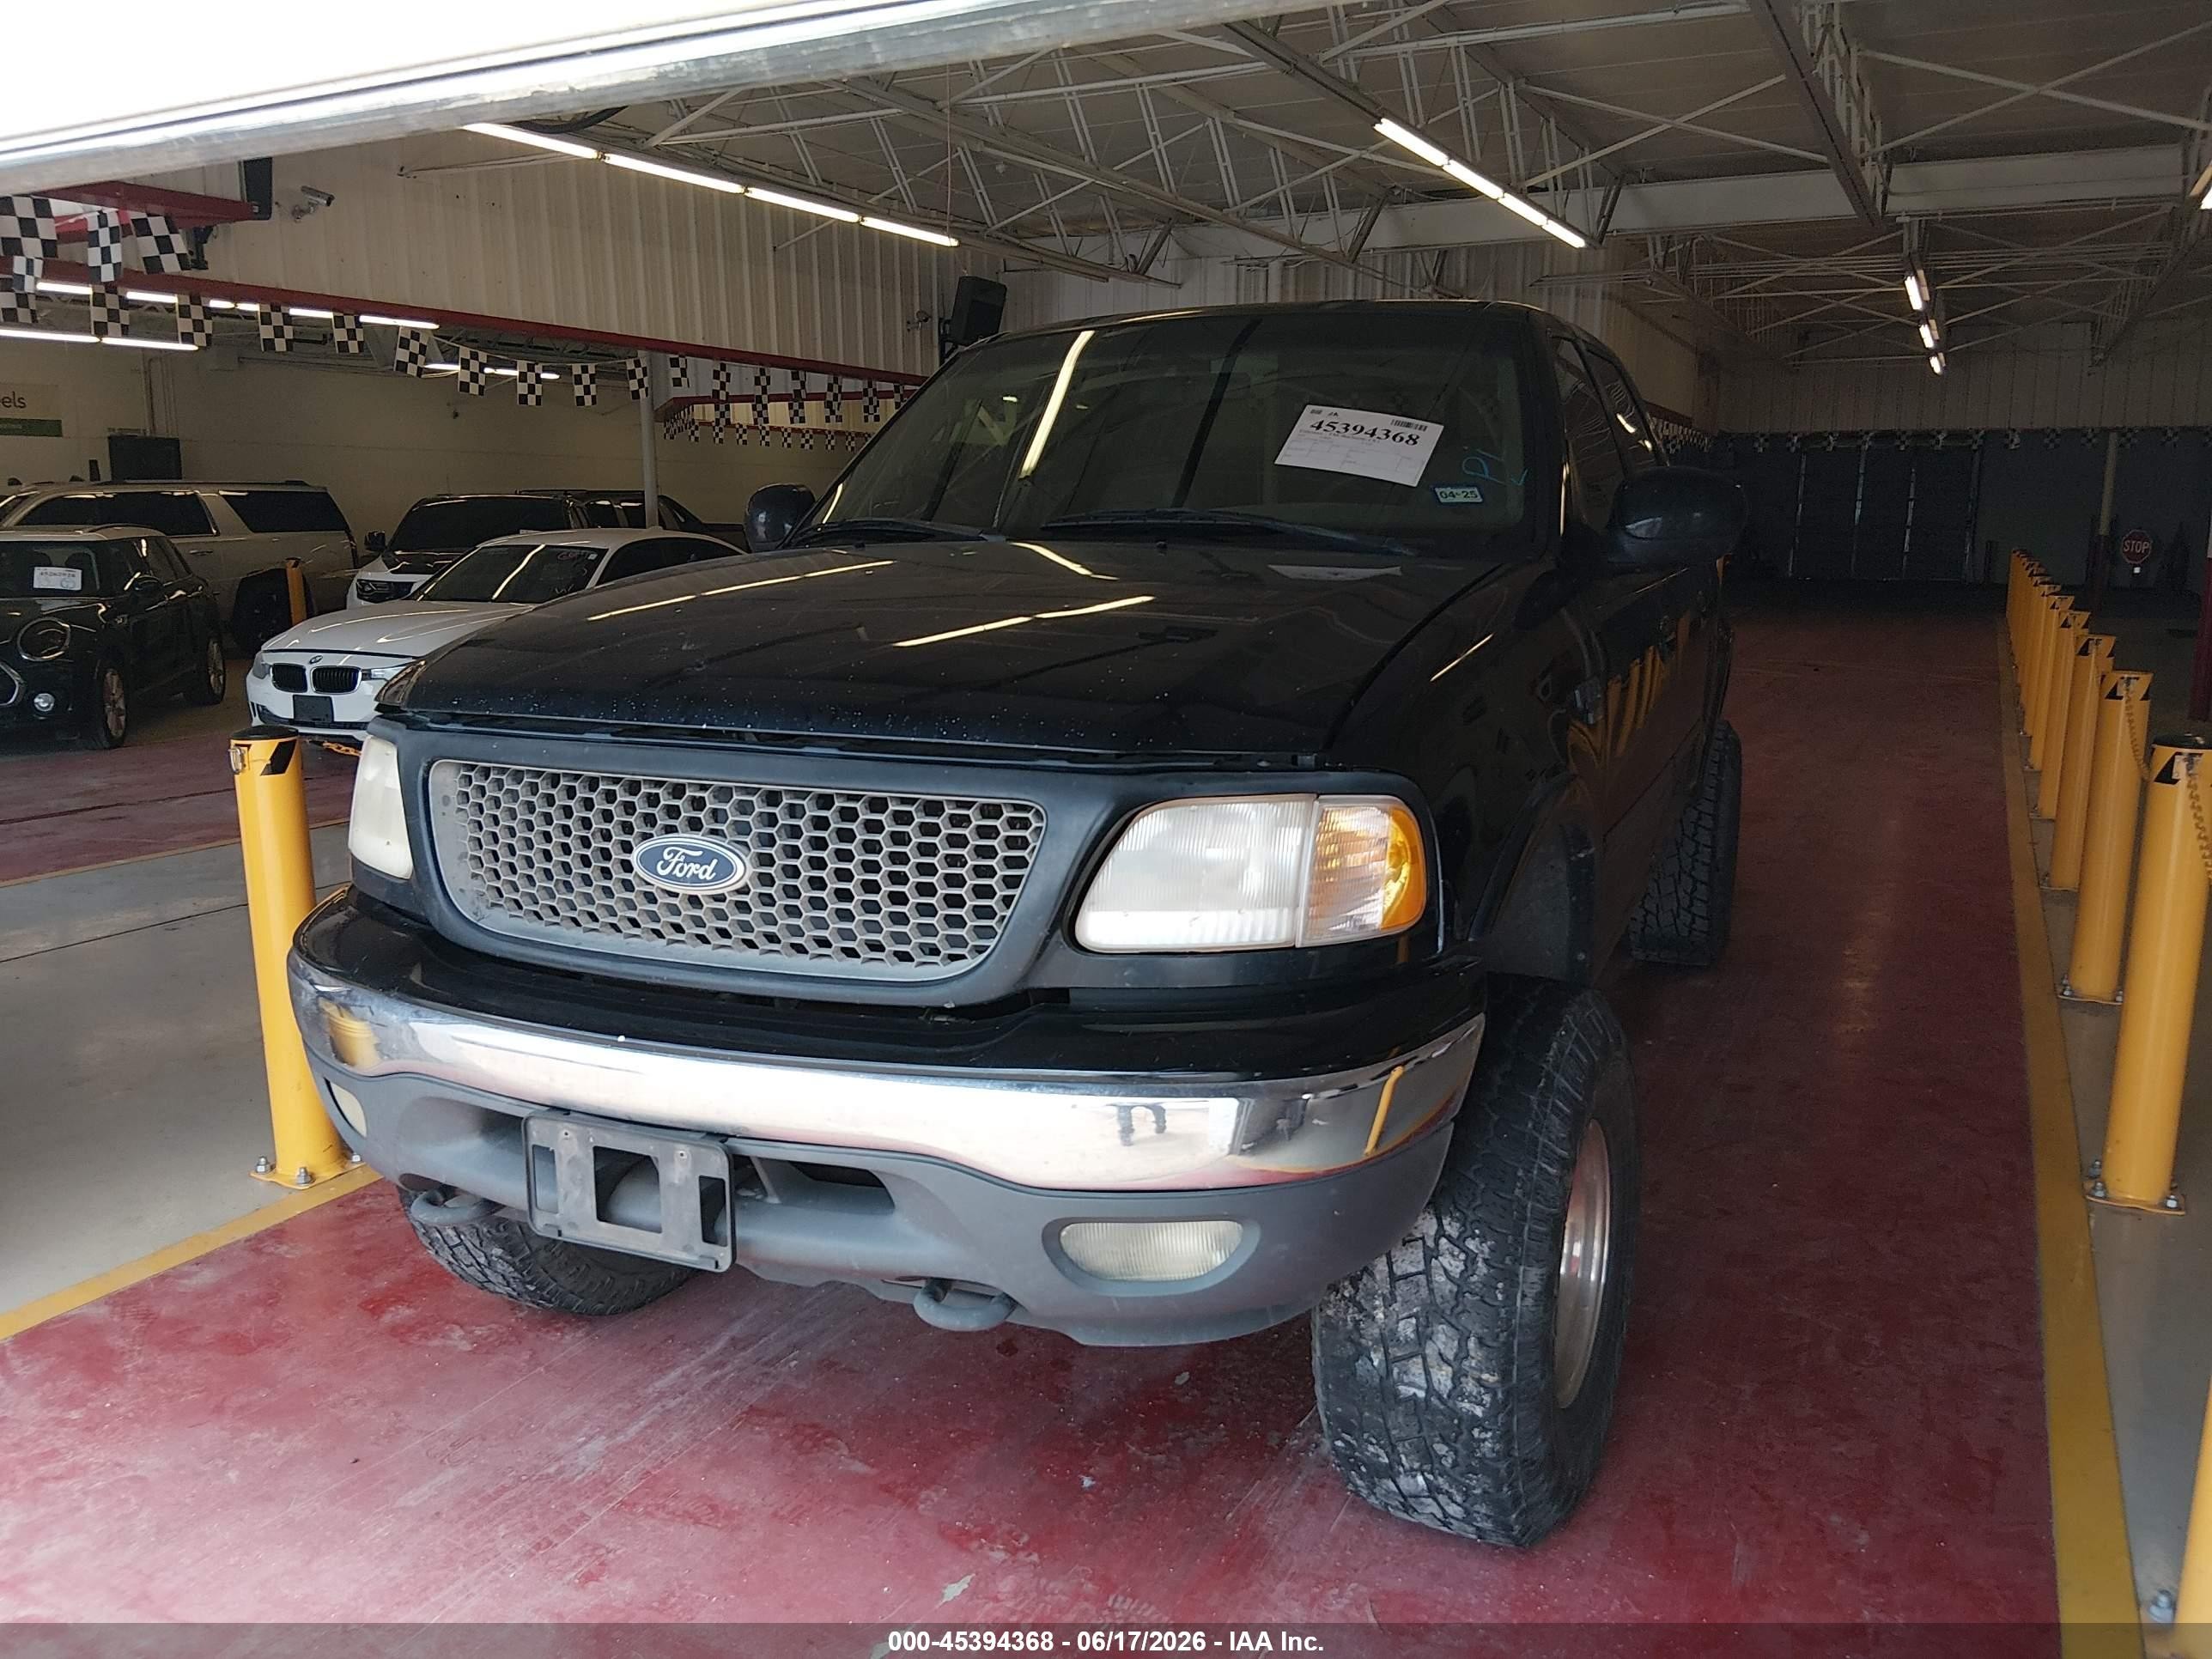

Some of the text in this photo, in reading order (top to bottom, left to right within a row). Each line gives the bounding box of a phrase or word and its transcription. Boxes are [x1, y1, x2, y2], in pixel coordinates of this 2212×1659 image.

[0, 391, 27, 409] els
[1310, 419, 1420, 446] 45394368
[2123, 540, 2150, 554] STOP
[656, 846, 719, 881] Ford
